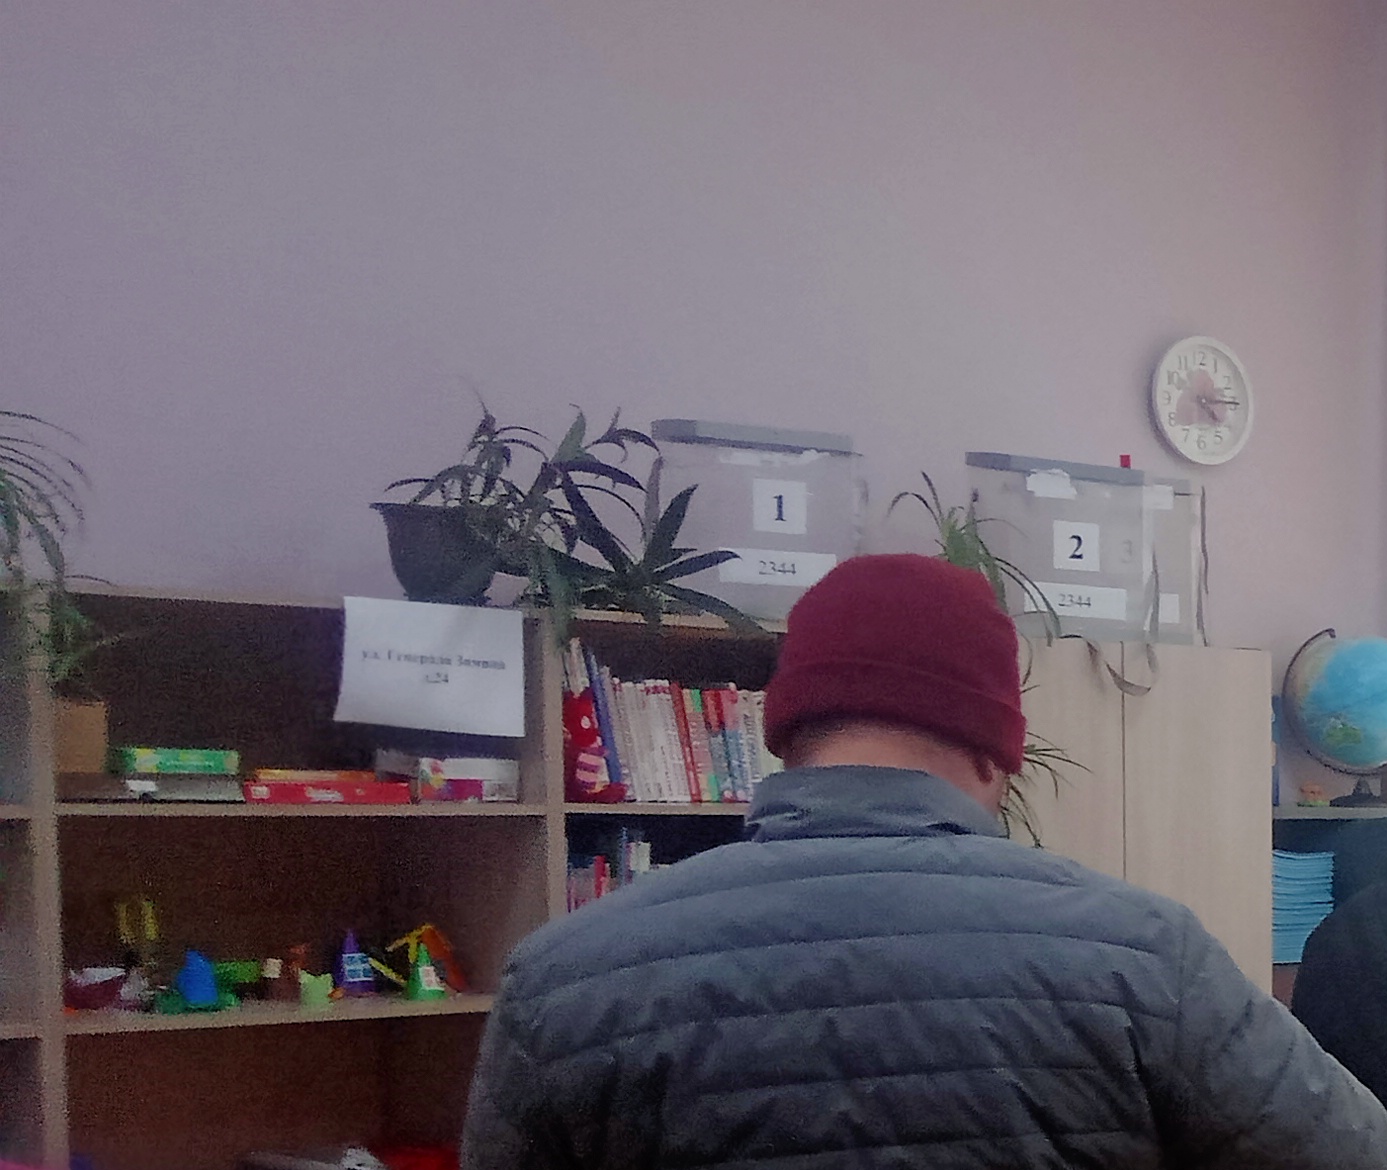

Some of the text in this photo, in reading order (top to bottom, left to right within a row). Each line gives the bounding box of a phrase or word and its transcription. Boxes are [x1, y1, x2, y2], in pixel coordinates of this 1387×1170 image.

[773, 494, 787, 522] 1
[1068, 534, 1084, 560] 2
[758, 559, 797, 575] 2344
[1058, 592, 1092, 607] 2344
